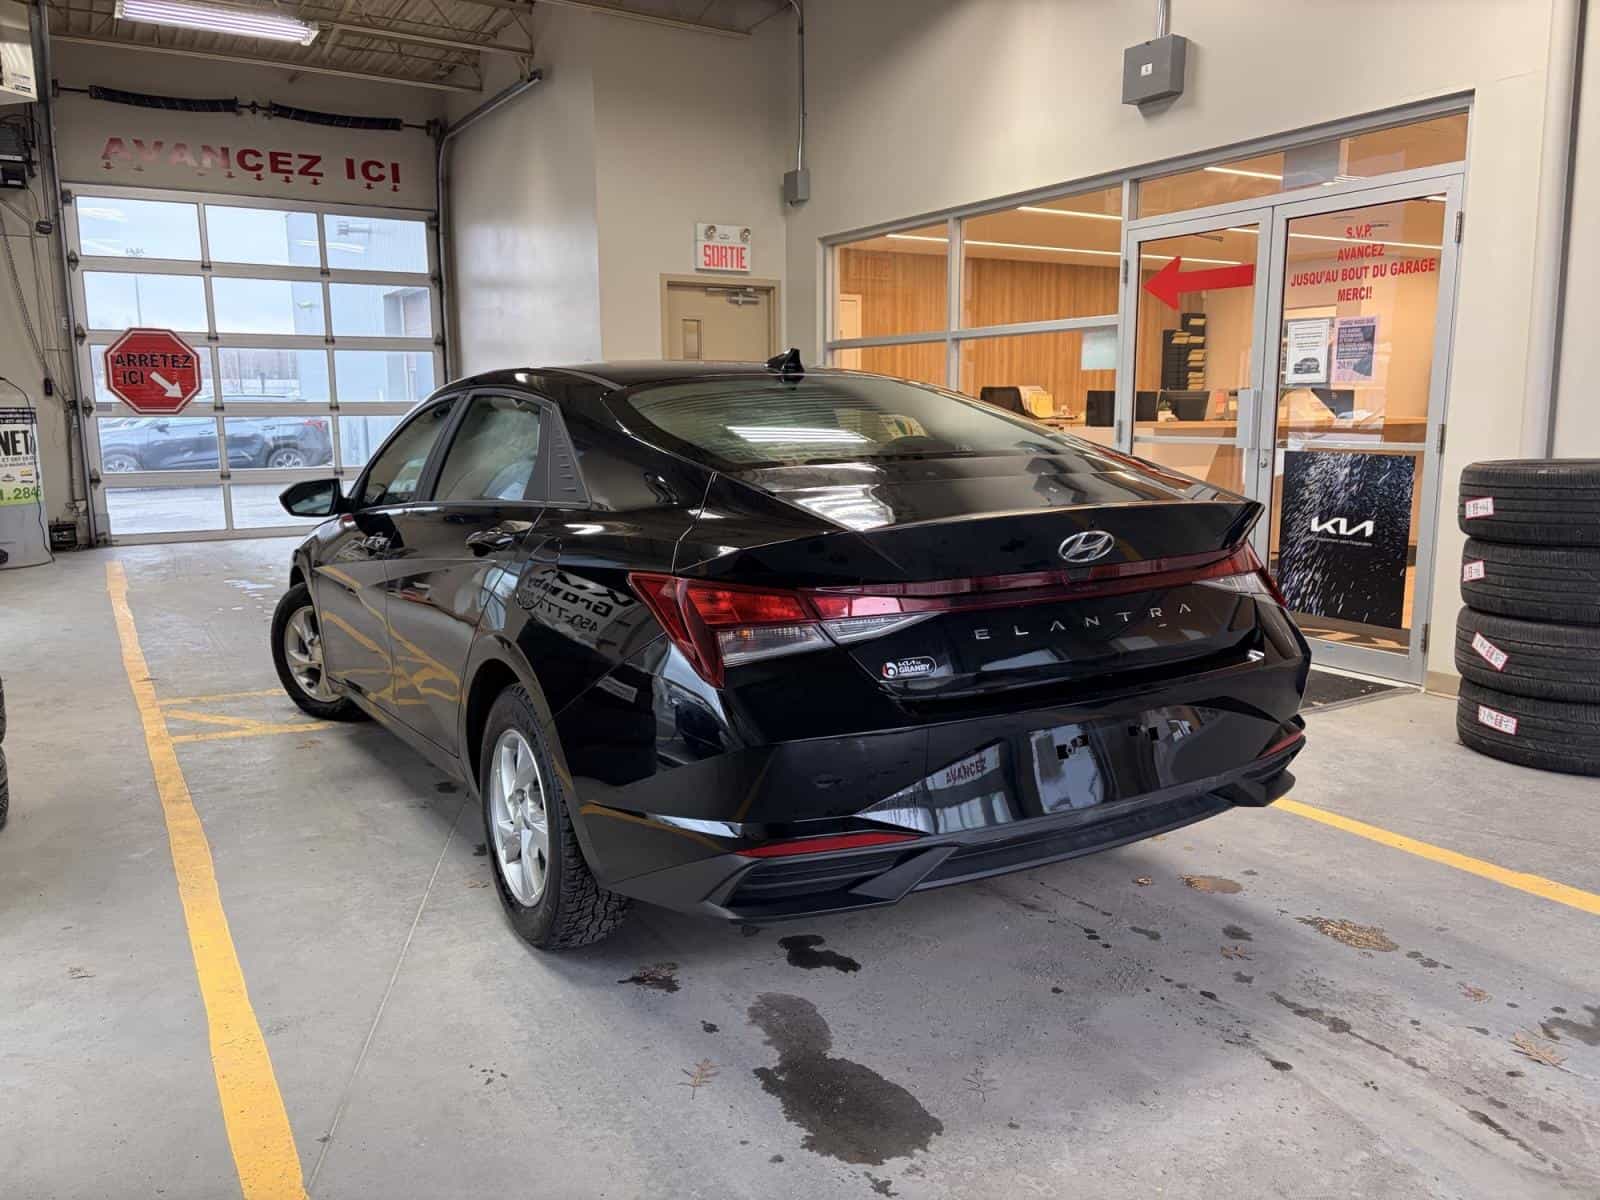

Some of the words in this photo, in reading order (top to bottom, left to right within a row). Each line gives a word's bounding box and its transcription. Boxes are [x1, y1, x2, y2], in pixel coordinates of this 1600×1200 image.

[102, 137, 324, 178] AVANCEZ
[344, 157, 401, 185] ICI
[1345, 223, 1373, 239] S.V.P.
[703, 244, 747, 269] SORTIE
[1337, 243, 1385, 262] AVANCEZ
[1290, 269, 1339, 287] JUSQU'AU
[1341, 266, 1370, 282] BOUT
[1372, 263, 1387, 278] DU
[1390, 258, 1436, 276] GARAGE
[1336, 286, 1373, 302] MERCI!
[122, 370, 146, 385] ICI
[1310, 516, 1375, 537] KIA
[974, 603, 1192, 640] ELANTRA
[899, 664, 929, 673] GRANBY
